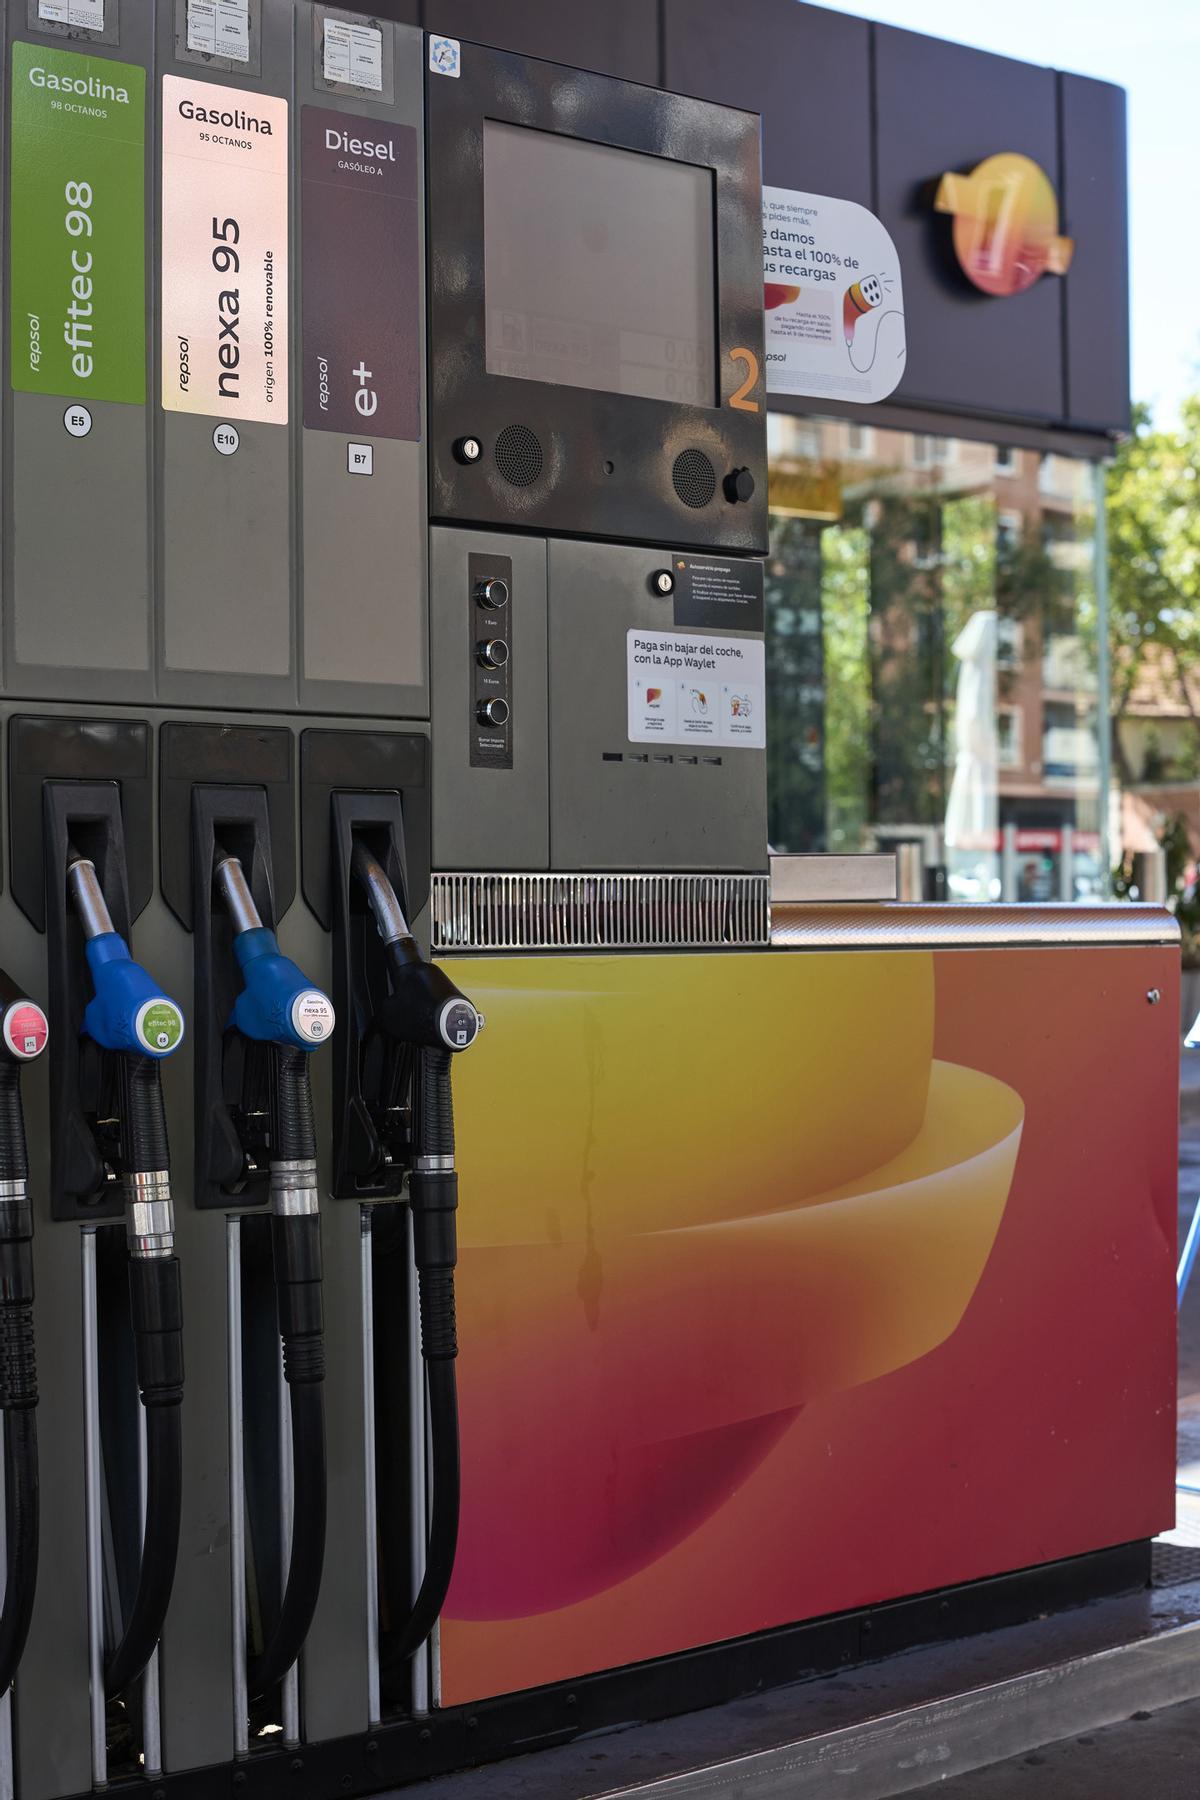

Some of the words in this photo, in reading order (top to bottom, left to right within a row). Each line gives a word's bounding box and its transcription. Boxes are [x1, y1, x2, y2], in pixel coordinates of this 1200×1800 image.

[29, 67, 129, 104] Gasolina
[50, 100, 62, 110] 98
[64, 103, 108, 118] OCTANOS
[178, 100, 273, 136] Gasolina
[199, 132, 210, 142] 95
[212, 135, 252, 150] OCTANOS
[325, 129, 396, 162] Diesel
[338, 160, 376, 174] GASÓLEO
[65, 180, 93, 237] 98
[769, 213, 791, 222] pides
[770, 202, 785, 210] que
[787, 205, 818, 216] siempre
[212, 217, 240, 274] 95
[770, 228, 815, 245] damos
[763, 245, 792, 258] asta
[795, 248, 806, 260] el
[810, 250, 841, 266] 100%
[844, 256, 860, 269] de
[763, 262, 776, 272] us
[780, 264, 836, 281] recargas
[264, 250, 274, 318] renovable
[64, 250, 93, 378] efitec
[28, 312, 42, 372] repsol
[218, 288, 240, 398] nexa
[264, 321, 274, 358] 100%
[178, 335, 191, 392] repsol
[766, 353, 787, 362] psol
[264, 361, 275, 402] origen
[317, 356, 330, 411] repsol
[352, 361, 378, 417] e+
[729, 348, 759, 412] 2
[71, 416, 84, 426] E5
[217, 434, 235, 445] E10
[354, 454, 366, 464] B7
[634, 640, 658, 652] Paga
[660, 642, 673, 652] sin
[674, 642, 698, 655] bajar
[700, 645, 714, 656] del
[716, 648, 744, 659] coche,
[634, 654, 651, 664] con
[653, 655, 662, 664] la
[664, 656, 682, 668] App
[684, 658, 716, 670] Waylet
